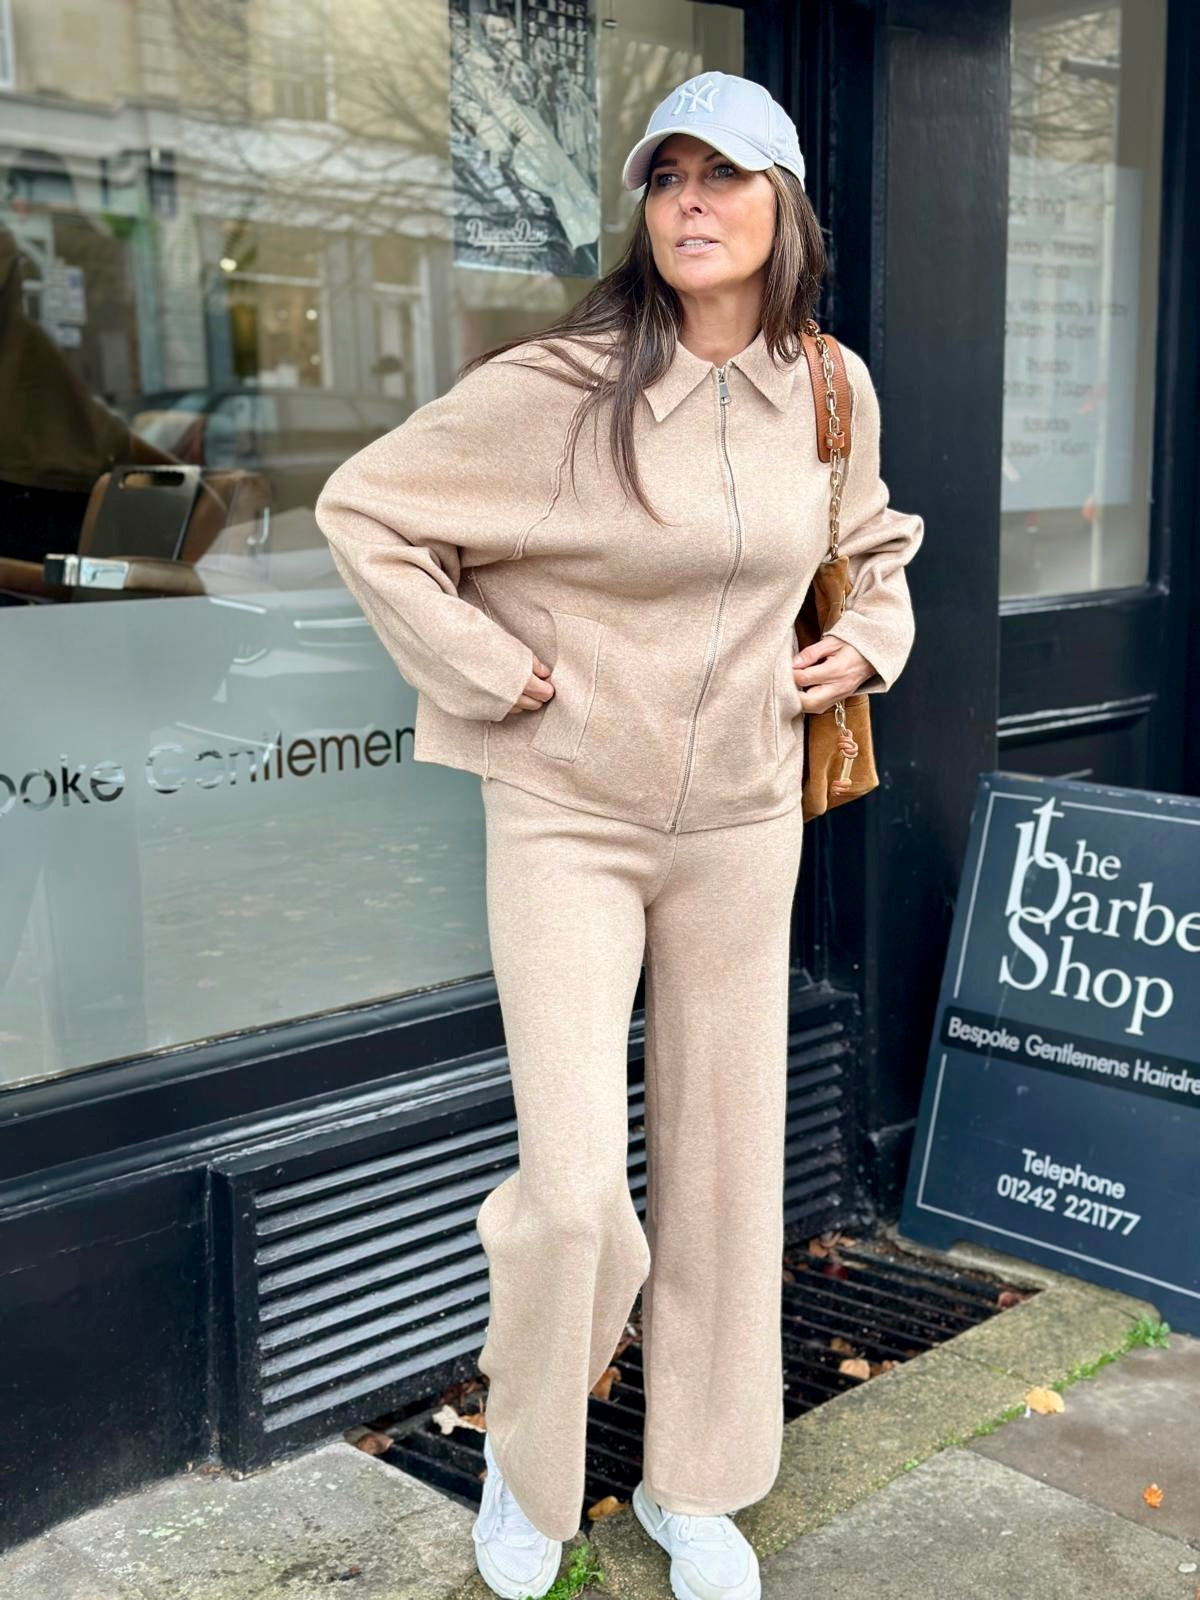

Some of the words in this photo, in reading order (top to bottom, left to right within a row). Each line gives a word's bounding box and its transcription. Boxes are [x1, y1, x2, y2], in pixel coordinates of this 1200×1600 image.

[671, 79, 720, 117] NY
[998, 906, 1175, 1036] Shop
[948, 1016, 1020, 1052] Bespoke
[1025, 1034, 1130, 1079] Gentlemens
[997, 1173, 1058, 1212] 01242
[1062, 1194, 1142, 1236] 221177
[1021, 1148, 1126, 1200] Telephone
